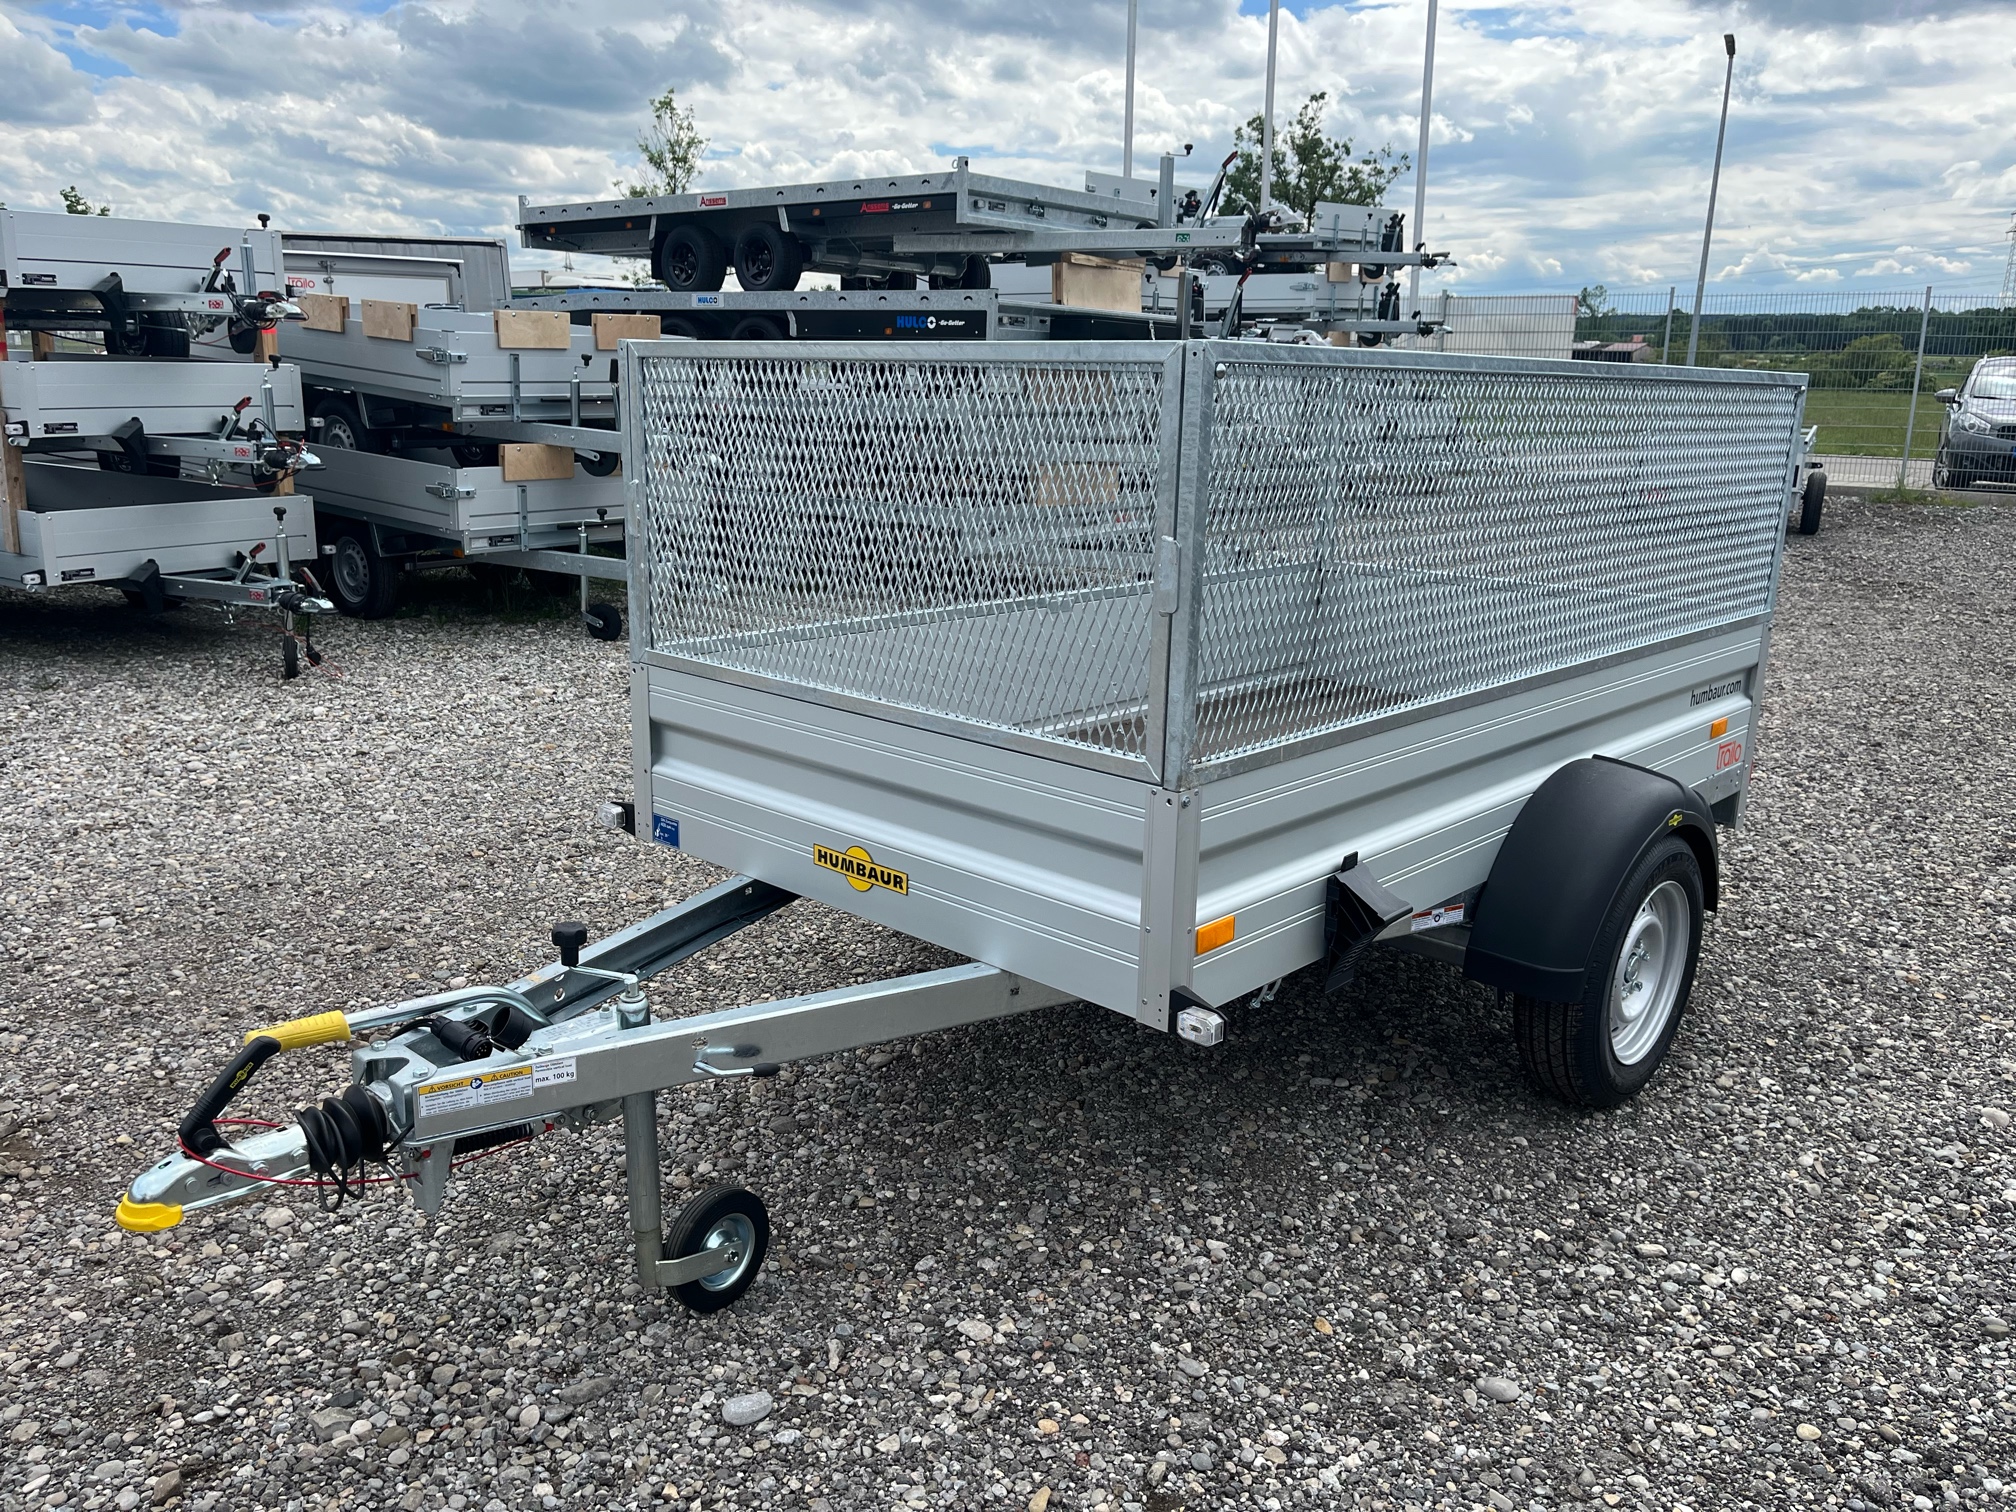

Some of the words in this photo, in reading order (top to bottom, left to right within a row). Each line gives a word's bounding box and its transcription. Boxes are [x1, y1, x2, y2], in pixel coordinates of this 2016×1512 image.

[697, 296, 718, 304] HULCO
[896, 315, 937, 330] HULCO
[1690, 680, 1742, 707] humbaur.com
[817, 848, 905, 892] HUMBAUR
[499, 1070, 524, 1079] CAUTION
[552, 1072, 566, 1080] 100
[566, 1071, 576, 1079] kg
[436, 1081, 464, 1092] VORSICHT
